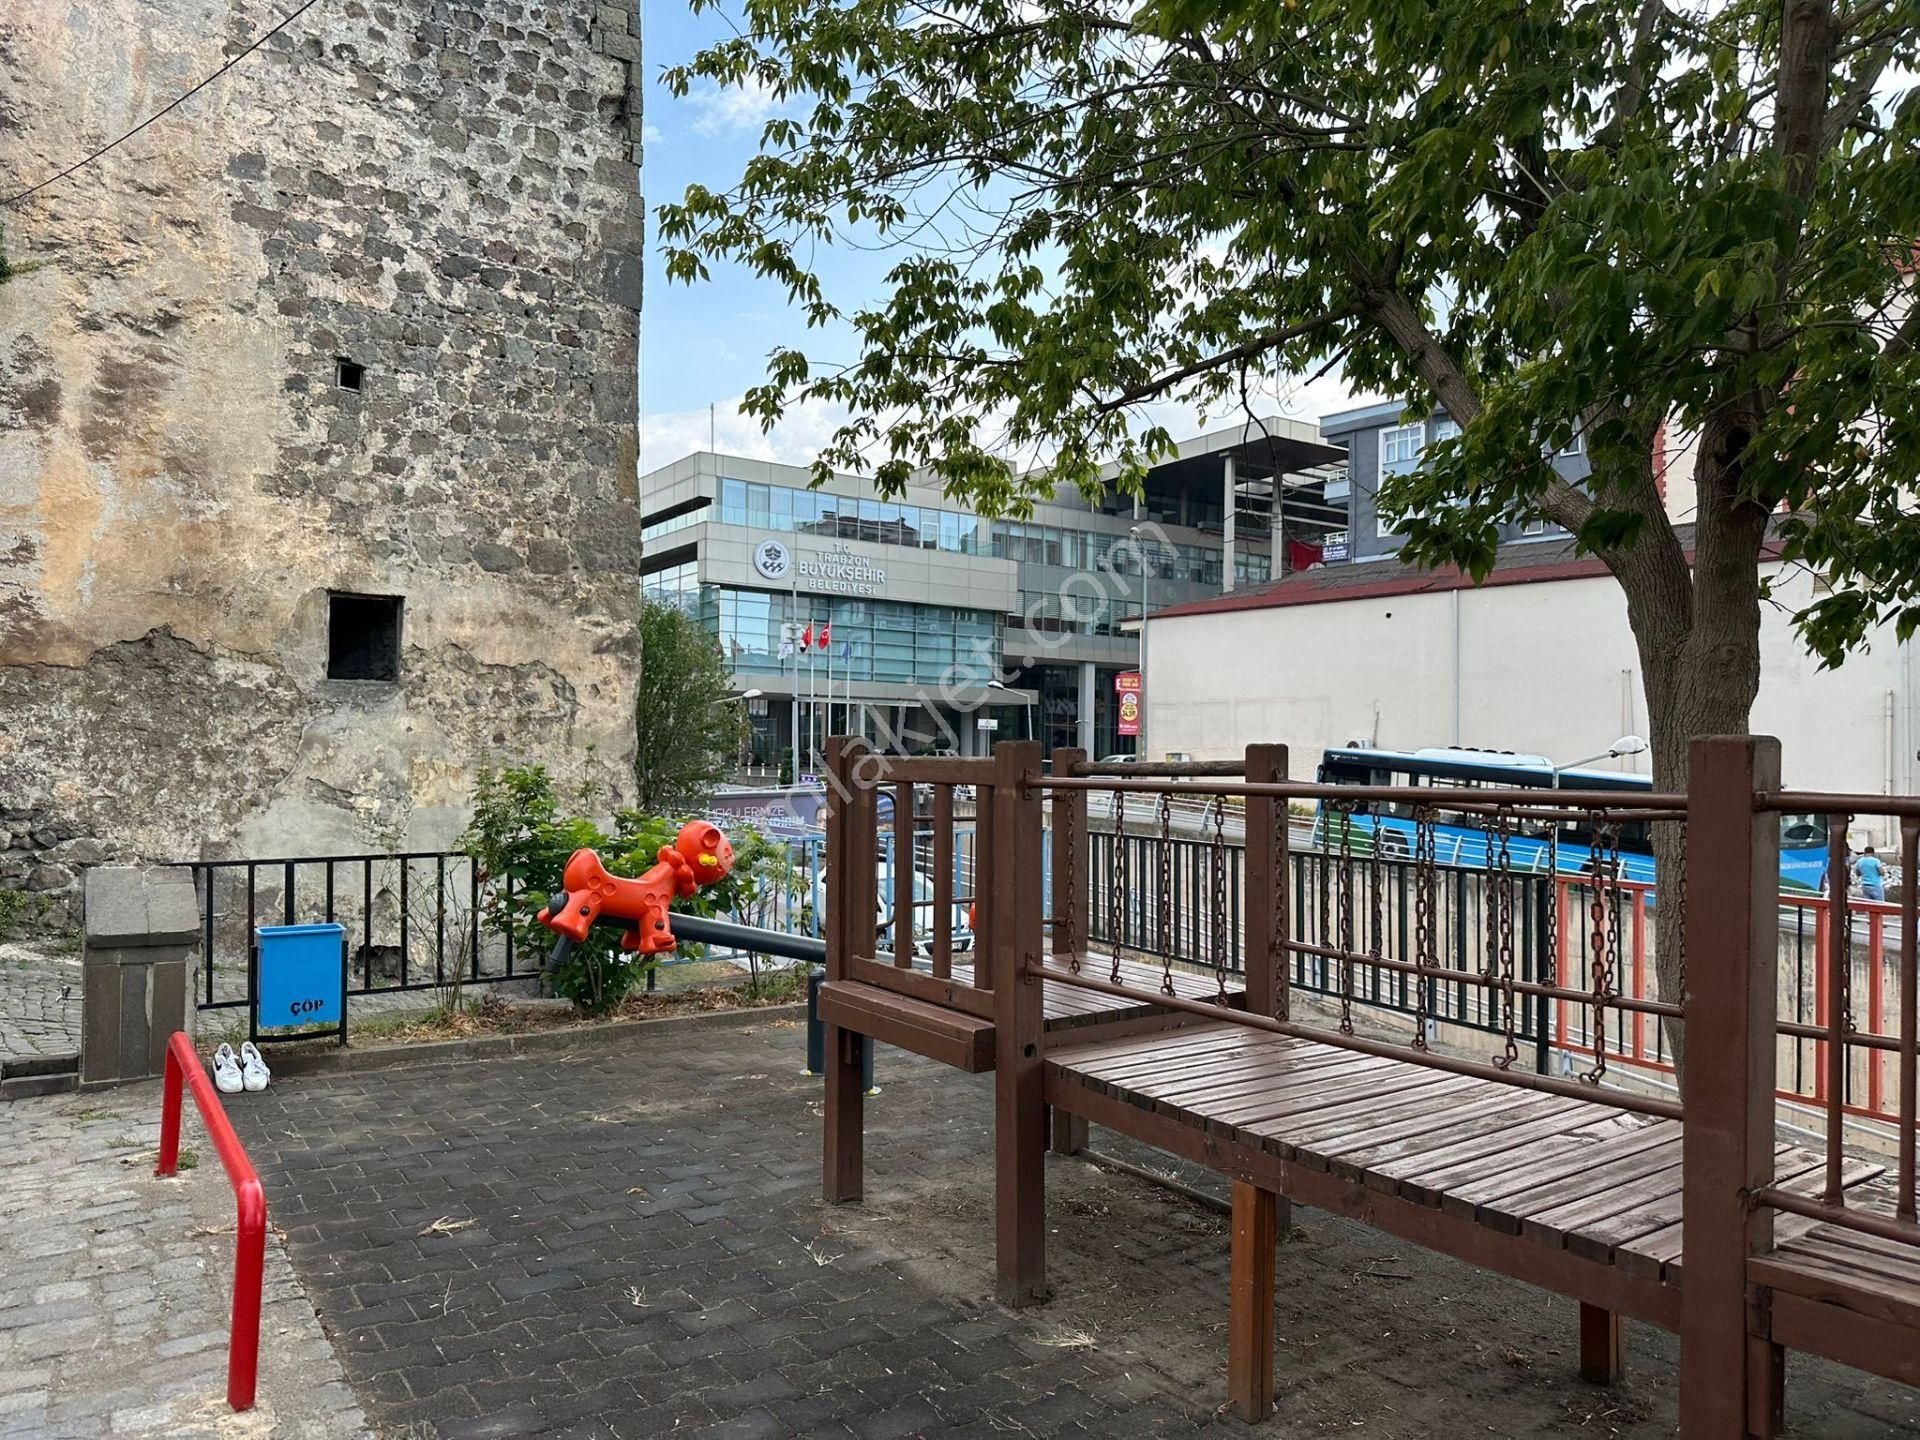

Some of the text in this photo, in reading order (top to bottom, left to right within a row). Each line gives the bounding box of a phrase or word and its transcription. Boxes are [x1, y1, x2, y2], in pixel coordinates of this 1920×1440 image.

[816, 552, 870, 567] TRABZON
[799, 561, 885, 583] BÜYÜKŞEHİR
[809, 580, 877, 594] BELEDİYESİ
[290, 998, 324, 1017] ÇÖP
